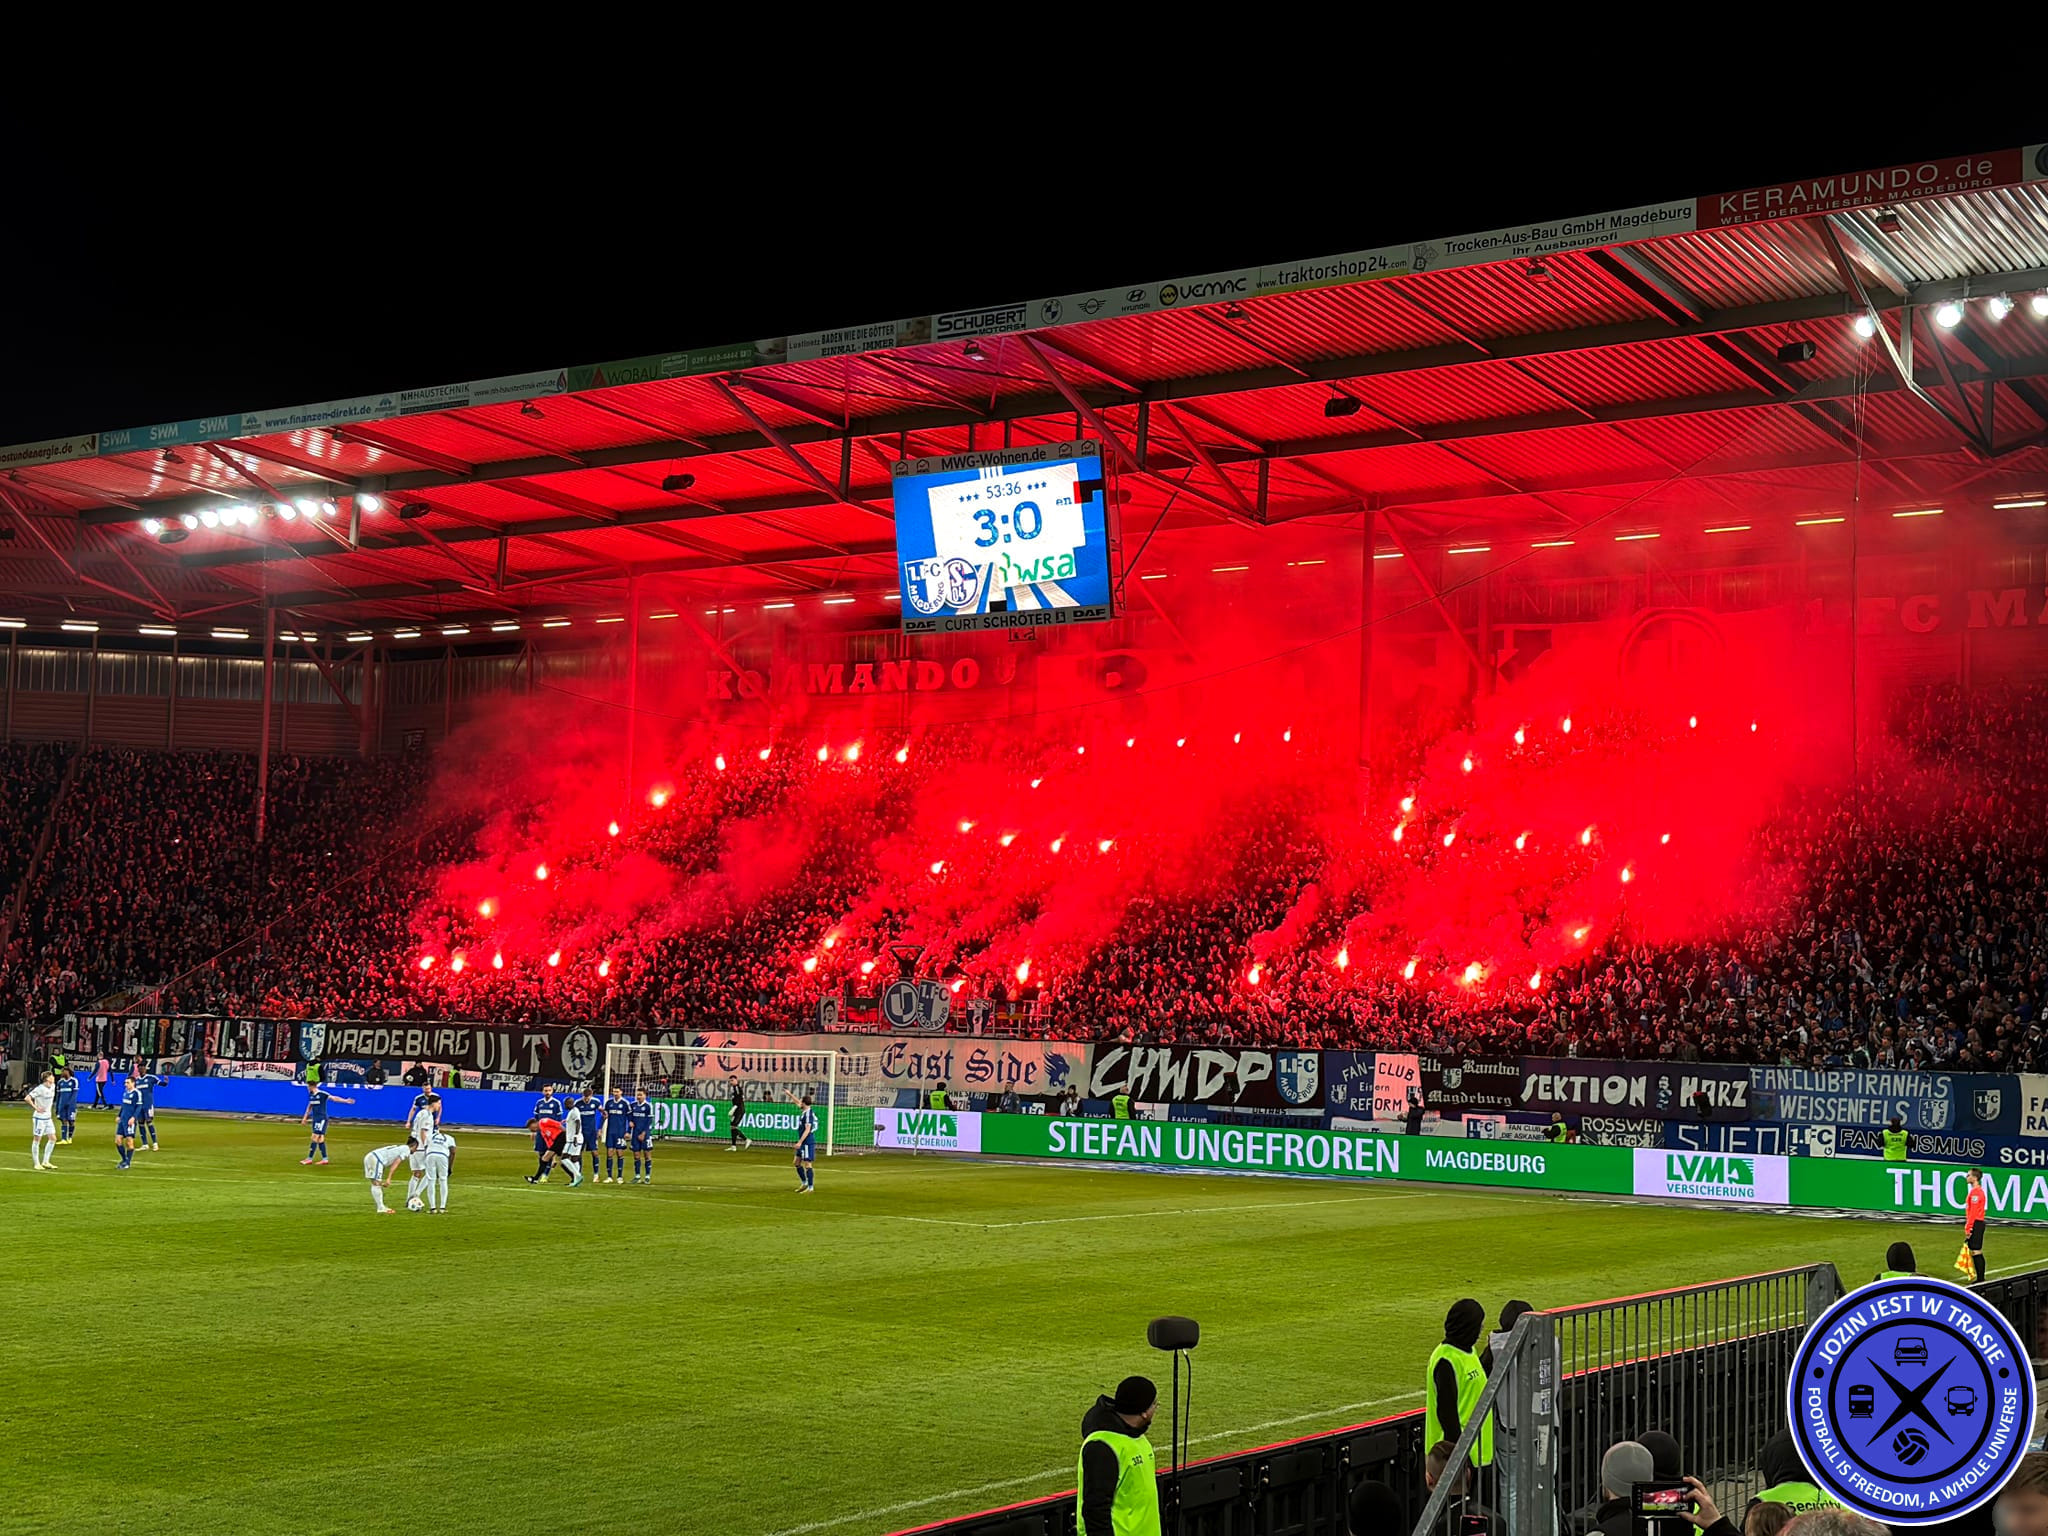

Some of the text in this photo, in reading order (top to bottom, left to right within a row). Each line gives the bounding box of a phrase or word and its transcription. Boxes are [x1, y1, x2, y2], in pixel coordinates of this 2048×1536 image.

[1720, 159, 1993, 214] KERAMUNDO.de
[1721, 211, 1760, 225] WELT
[1768, 206, 1798, 218] DER
[1806, 196, 1873, 213] FLIESEN
[1888, 177, 1993, 201] MAGDEBURG
[1445, 207, 1691, 253] Trocken-Aus-Bau GmbH Magdeburg
[1513, 232, 1618, 255] Ihr Ausbauprofi
[938, 309, 1026, 332] SCHUBERT
[821, 332, 843, 345] BADEN
[821, 344, 856, 356] EINMAL
[862, 339, 895, 351] IMMER
[608, 366, 658, 386] WOBAU
[149, 424, 179, 441] SWM
[199, 417, 229, 434] SWM
[102, 432, 131, 448] SWM
[941, 448, 1047, 472] MWG-Wohnen.de
[986, 481, 1022, 499] 53:36
[973, 501, 1042, 547] 3:0
[905, 620, 937, 630] DAF
[944, 612, 1052, 632] CURT SCHRÖTER
[1073, 608, 1106, 619] DAF
[327, 1028, 471, 1056] MAGDEBURG
[880, 1042, 953, 1082] East
[964, 1047, 1037, 1085] Side
[1089, 1046, 1273, 1103] CHWDP
[1280, 1076, 1315, 1101] MAGDEBURG
[1427, 1090, 1513, 1107] Magdeburg
[1520, 1073, 1648, 1108] SEKTION
[1350, 1097, 1402, 1112] REFORM
[1779, 1095, 1910, 1125] WEISSENFELS
[739, 1113, 819, 1132] MAGDEBUG
[897, 1136, 958, 1148] VERSICHERUNG
[1048, 1120, 1400, 1173] STEFAN UNGEFROREN
[1840, 1129, 1985, 1158] FANISMUS
[1425, 1149, 1546, 1174] MAGDEBURG
[2000, 1146, 2048, 1166] SCH
[1666, 1154, 1724, 1183] LVM
[1666, 1184, 1755, 1198] VERSICHERUNG
